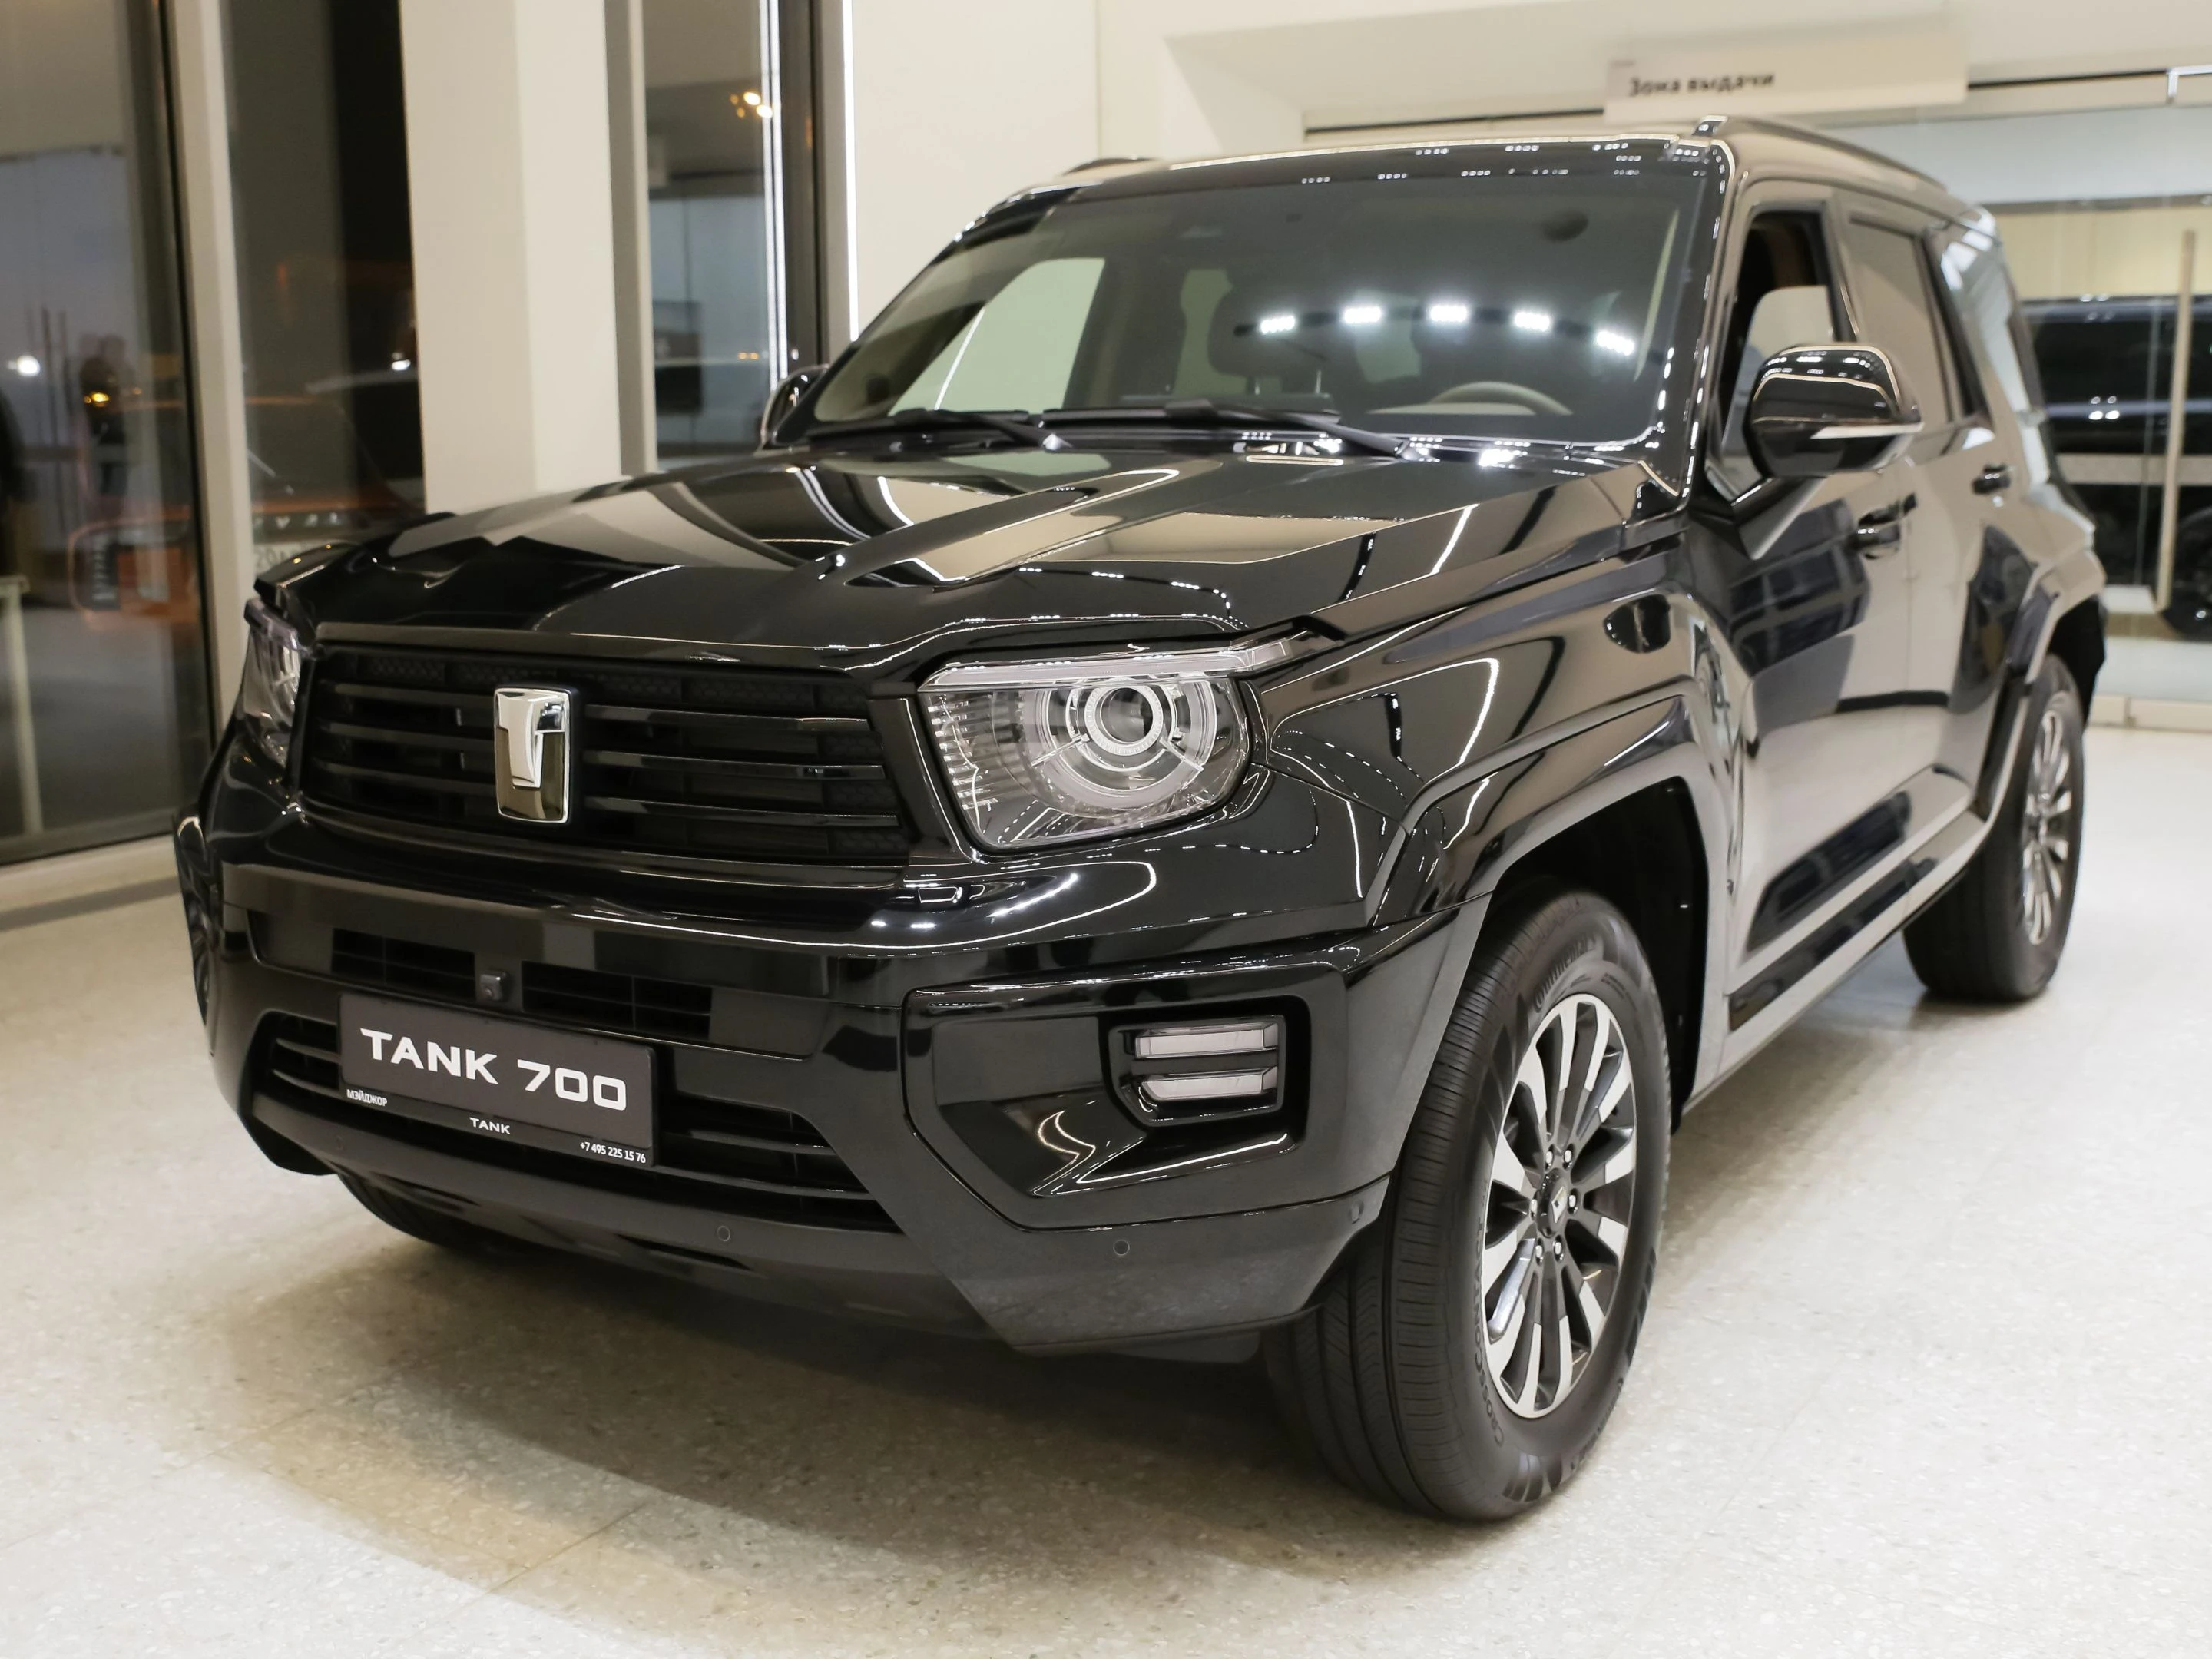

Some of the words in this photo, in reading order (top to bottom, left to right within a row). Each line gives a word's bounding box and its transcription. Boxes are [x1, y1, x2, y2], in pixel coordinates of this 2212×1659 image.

[1629, 75, 1681, 98] Зона
[1687, 74, 1776, 93] выдачи
[360, 1028, 498, 1084] TANK
[517, 1059, 627, 1111] 700
[346, 1088, 388, 1107] МЭЙДЖОР
[469, 1117, 511, 1135] TANK
[580, 1141, 591, 1151] +7
[591, 1143, 607, 1155] 495
[608, 1147, 623, 1159] 225
[624, 1150, 635, 1161] 15
[636, 1152, 647, 1164] 76
